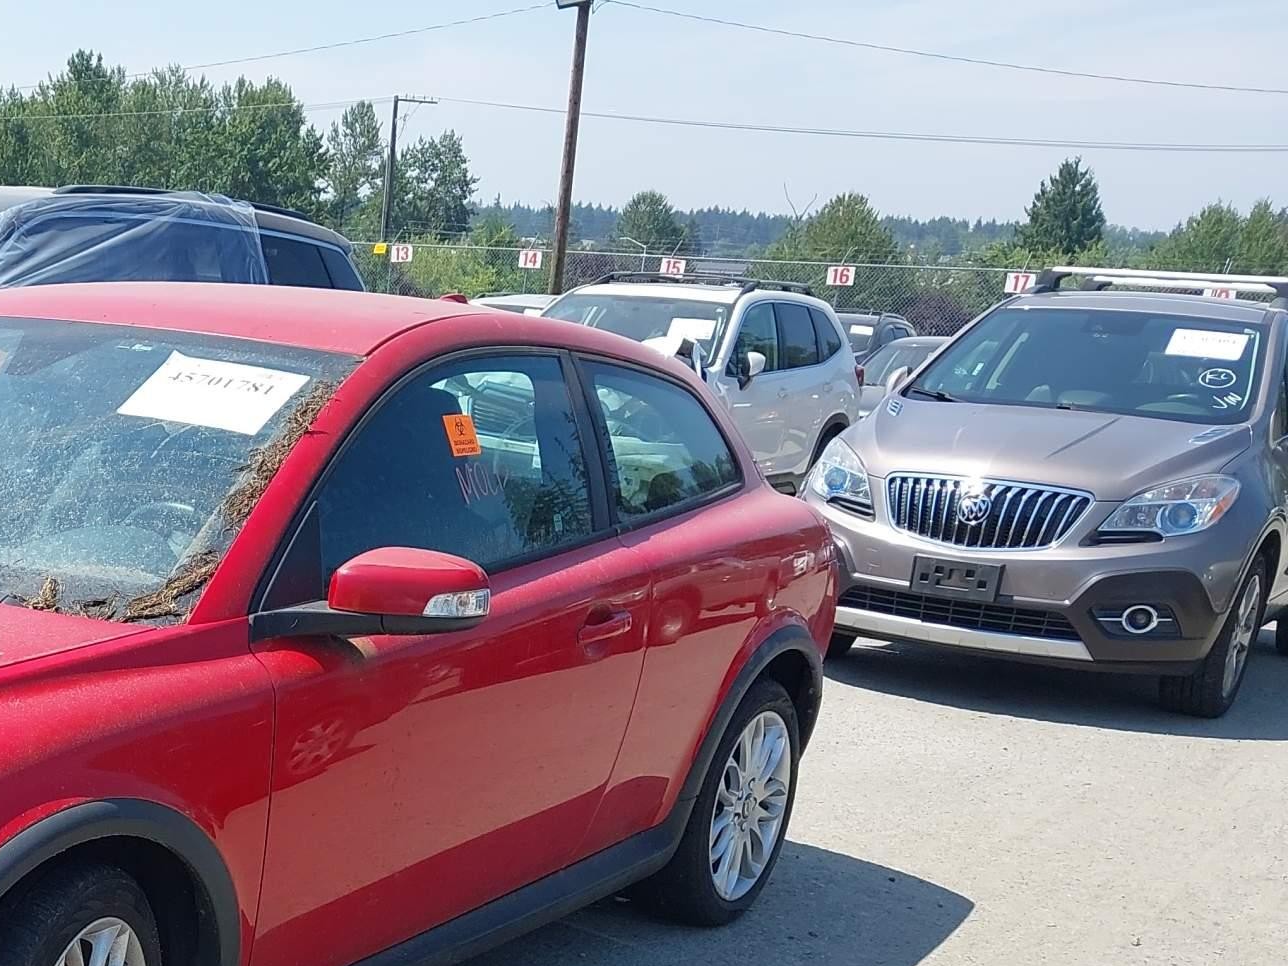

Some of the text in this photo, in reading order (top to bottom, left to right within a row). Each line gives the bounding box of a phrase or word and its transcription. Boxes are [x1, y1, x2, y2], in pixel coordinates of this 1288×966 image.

[395, 246, 410, 262] 13
[522, 252, 538, 267] 14
[664, 260, 681, 275] 15
[832, 267, 850, 284] 16
[1013, 274, 1031, 292] 17
[167, 371, 275, 395] 45701781
